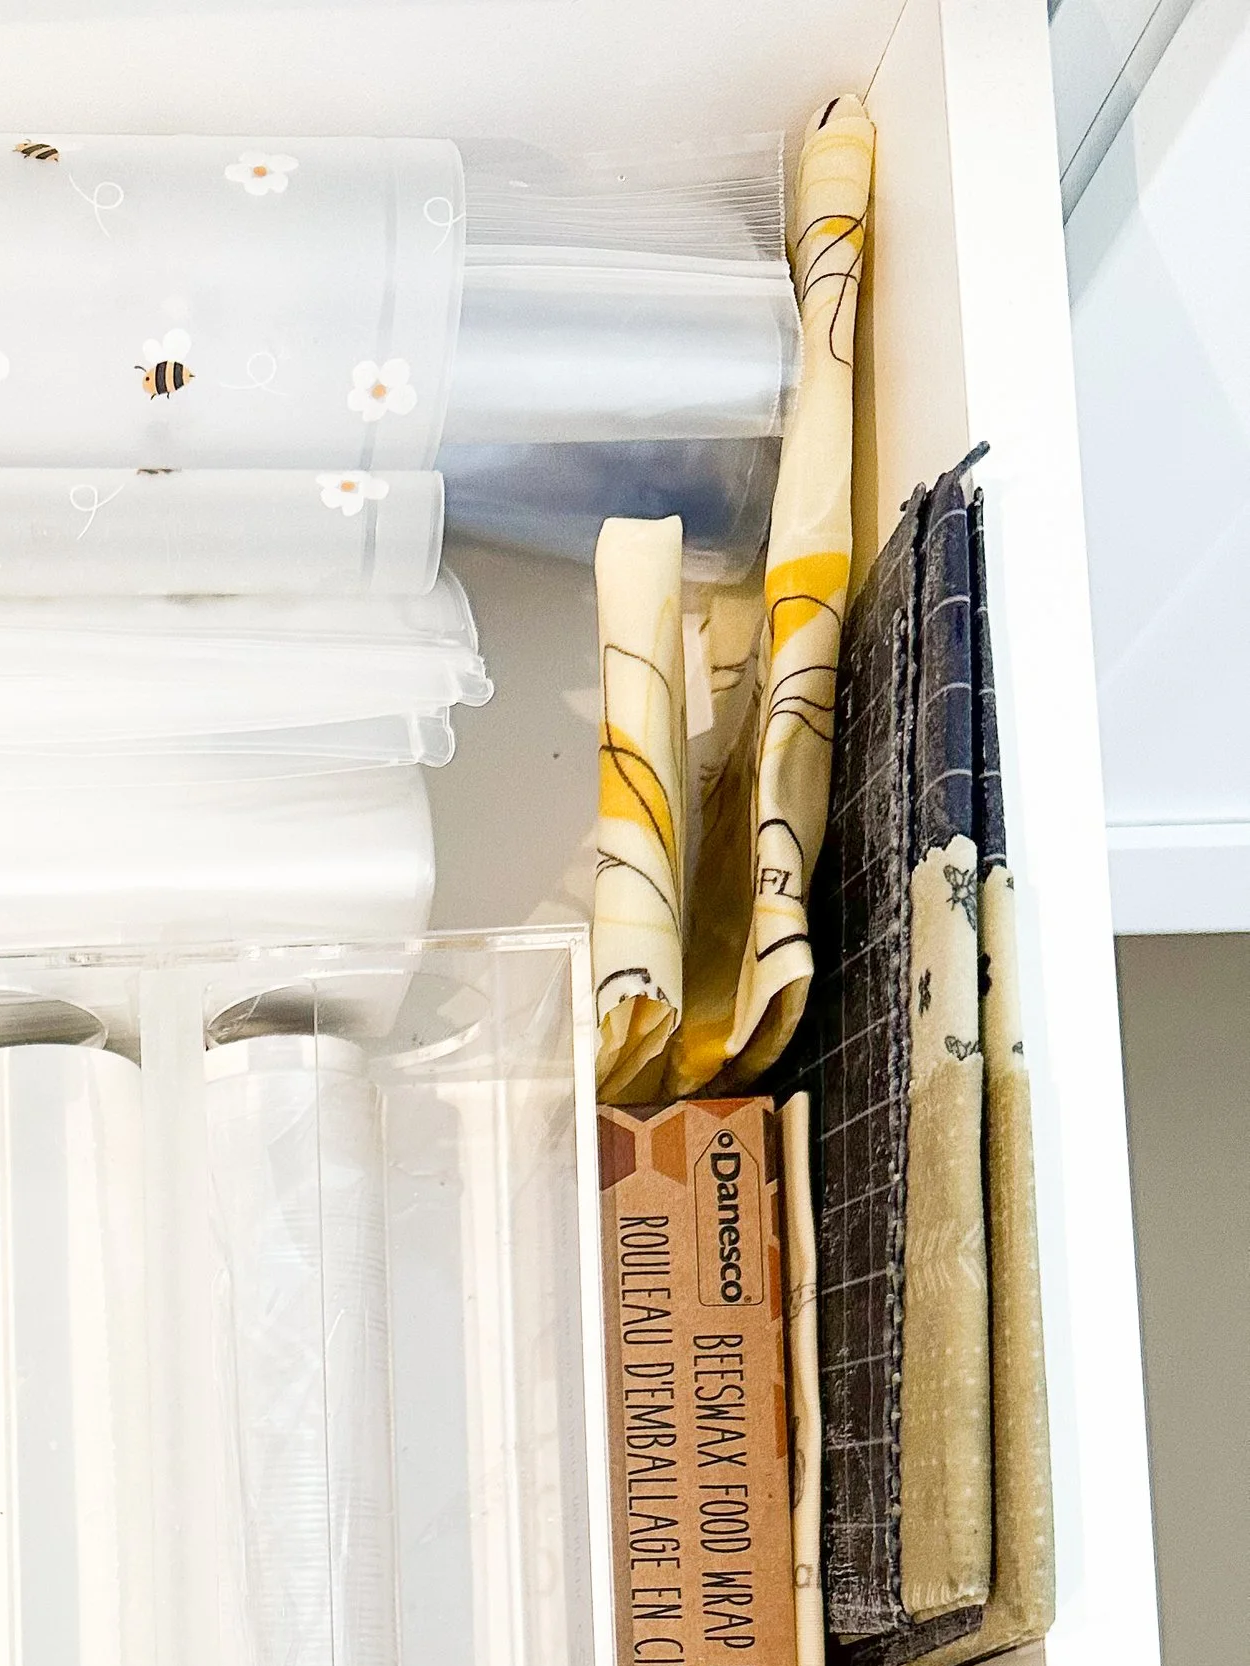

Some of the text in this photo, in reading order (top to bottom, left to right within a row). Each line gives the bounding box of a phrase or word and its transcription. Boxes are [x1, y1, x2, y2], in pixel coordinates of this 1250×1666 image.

[620, 1215, 673, 1346] ROULEAU
[710, 1151, 741, 1303] Danesco
[692, 1334, 746, 1468] BEESWAX
[624, 1363, 681, 1571] D'EMBALLAGE
[698, 1484, 752, 1554] FOOD
[631, 1587, 683, 1622] EN
[702, 1571, 756, 1650] WRAP
